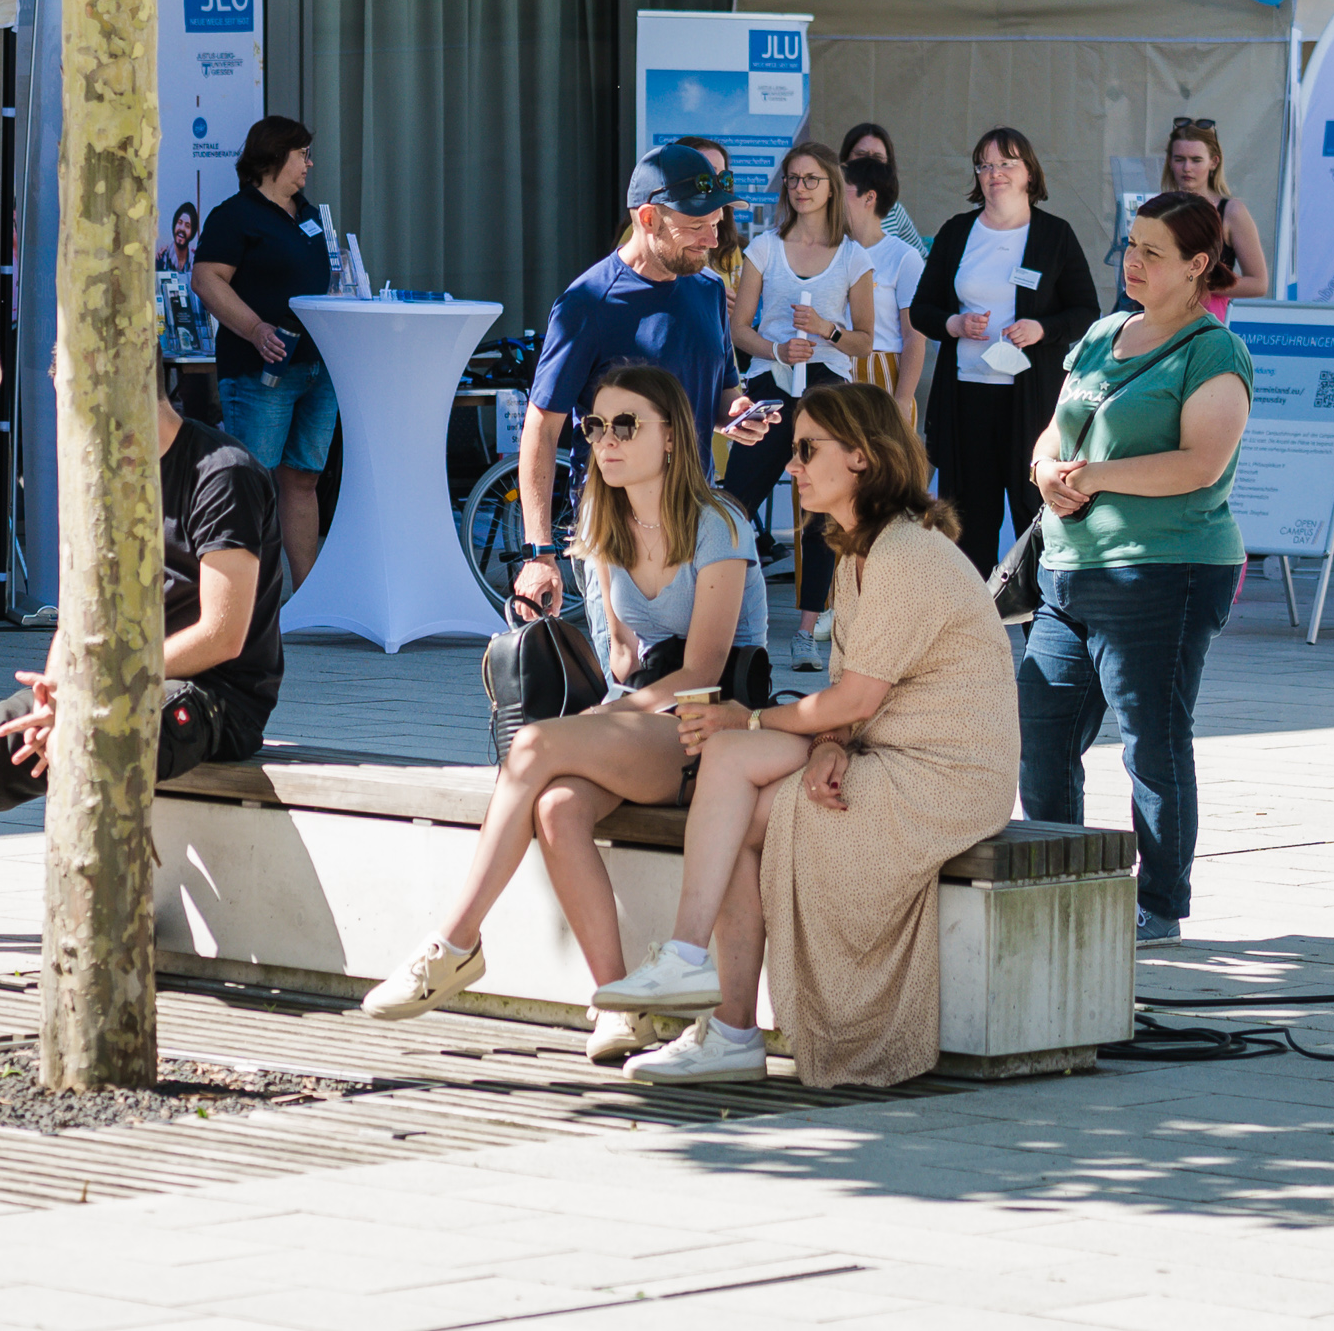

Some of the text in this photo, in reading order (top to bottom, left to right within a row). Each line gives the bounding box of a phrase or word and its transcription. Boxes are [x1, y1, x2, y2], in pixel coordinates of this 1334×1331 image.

[761, 35, 799, 60] JLU
[1295, 519, 1317, 528] OPEN
[1279, 527, 1314, 536] CAMPUS
[1293, 536, 1310, 544] DAY
